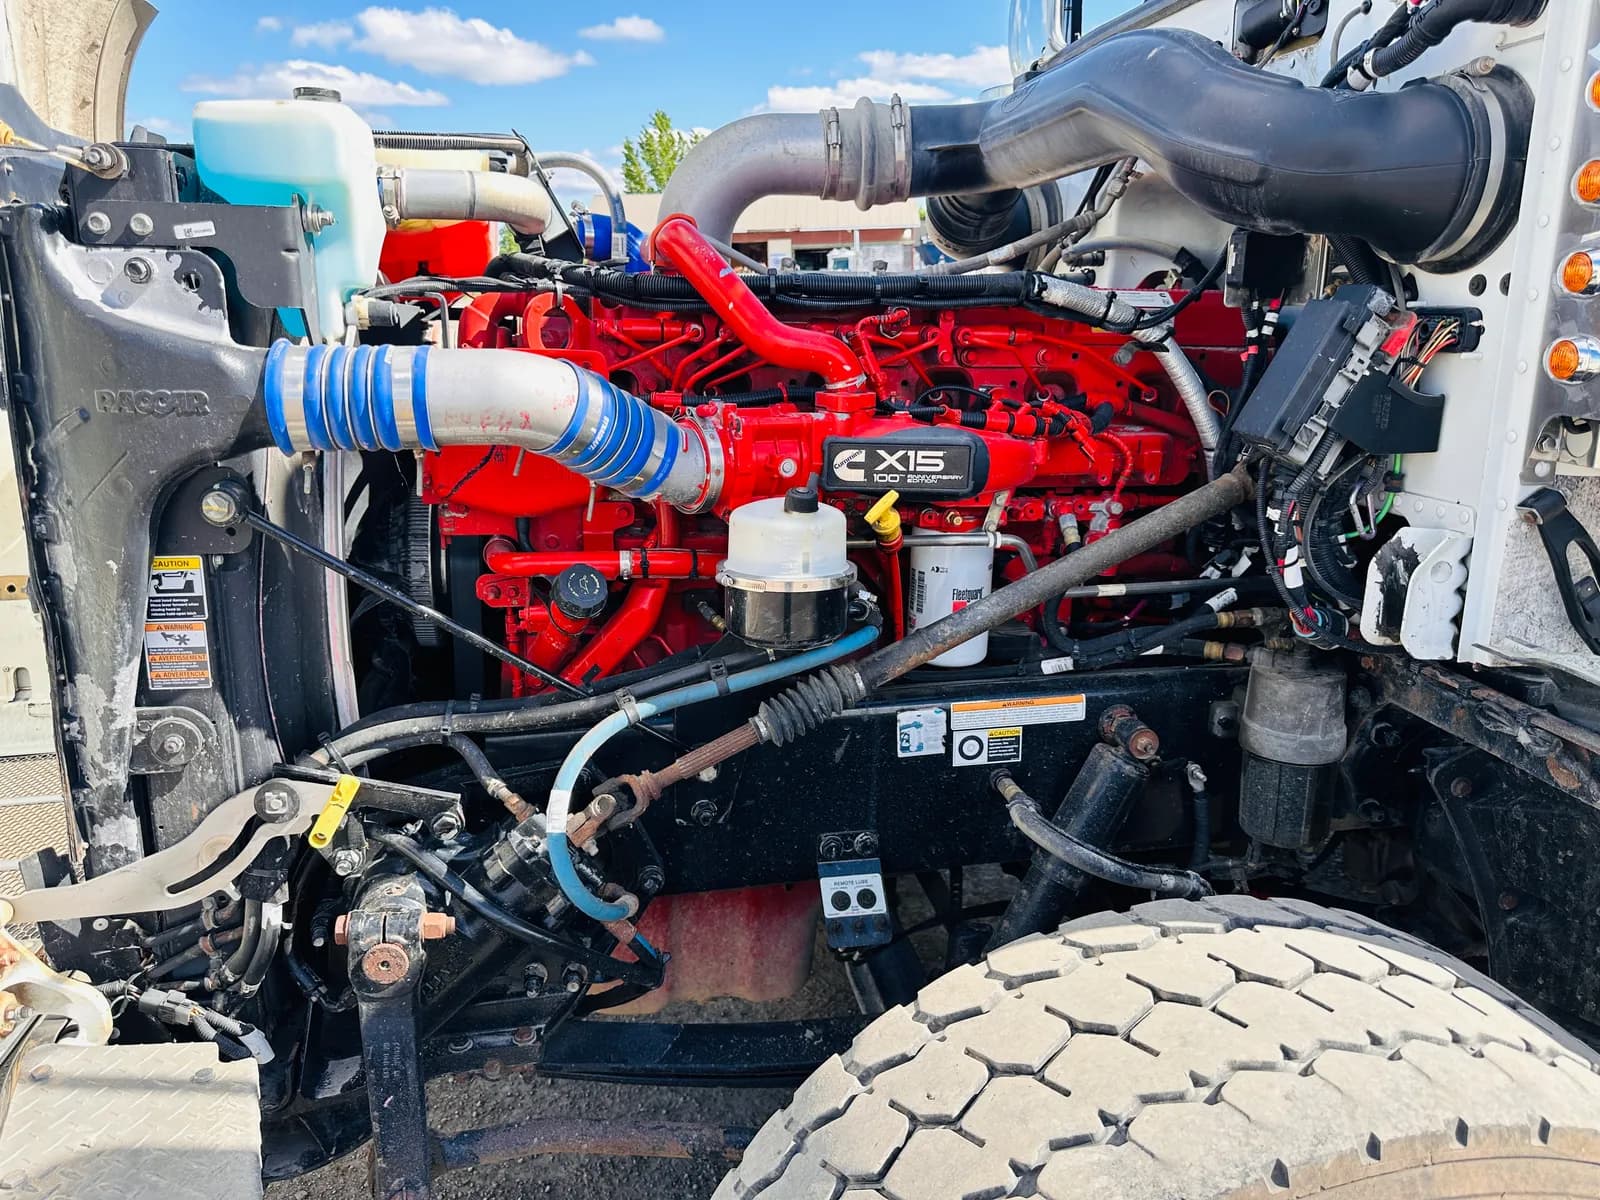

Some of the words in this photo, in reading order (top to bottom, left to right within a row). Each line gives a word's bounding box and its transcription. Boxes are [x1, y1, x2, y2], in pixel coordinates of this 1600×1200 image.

[95, 389, 210, 416] PACCAR
[833, 449, 864, 470] Cummins
[993, 729, 1020, 737] CAUTION
